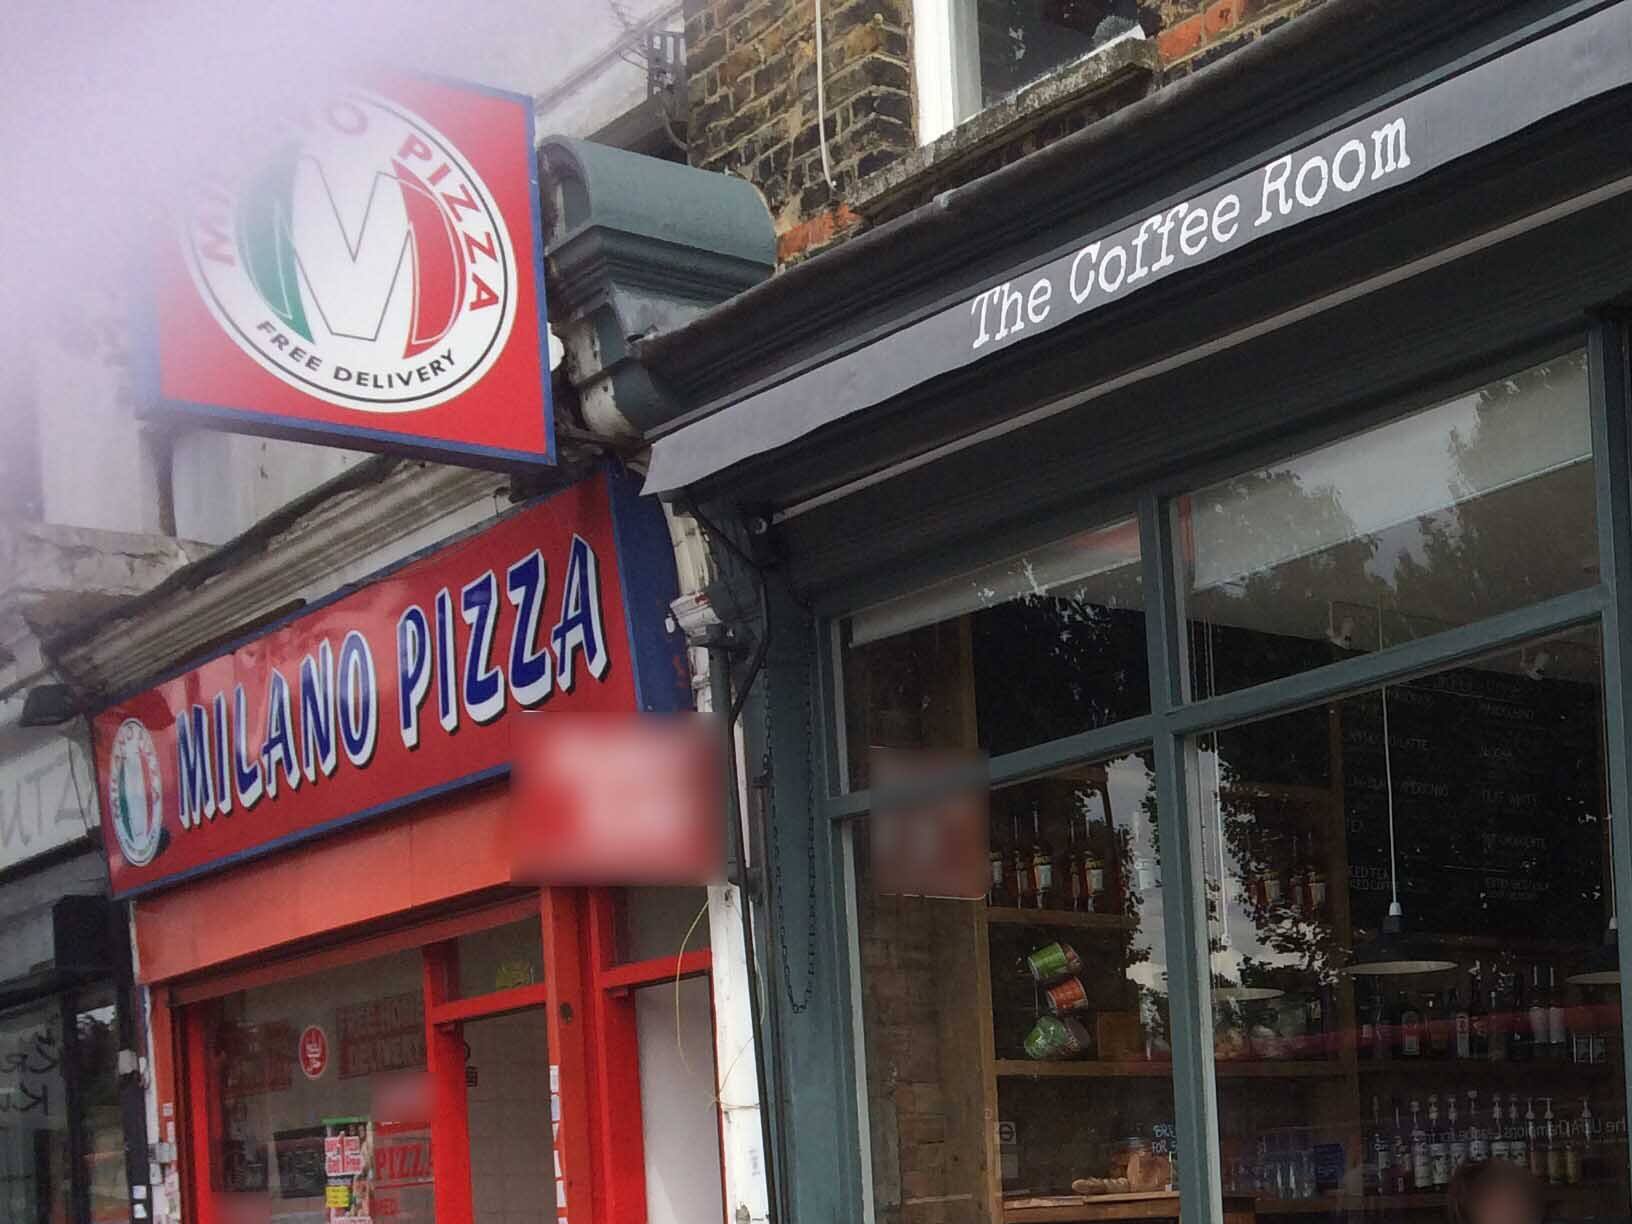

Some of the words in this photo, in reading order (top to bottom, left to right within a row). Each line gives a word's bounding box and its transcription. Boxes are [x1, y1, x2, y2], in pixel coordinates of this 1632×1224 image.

[398, 132, 500, 312] PIZZA
[971, 278, 1053, 349] The
[1069, 194, 1240, 303] Coffee
[1254, 117, 1411, 227] Room
[257, 319, 323, 372] FREE
[333, 350, 457, 389] DELIVERY
[176, 629, 378, 830] MILANO
[396, 533, 607, 749] PIZZA
